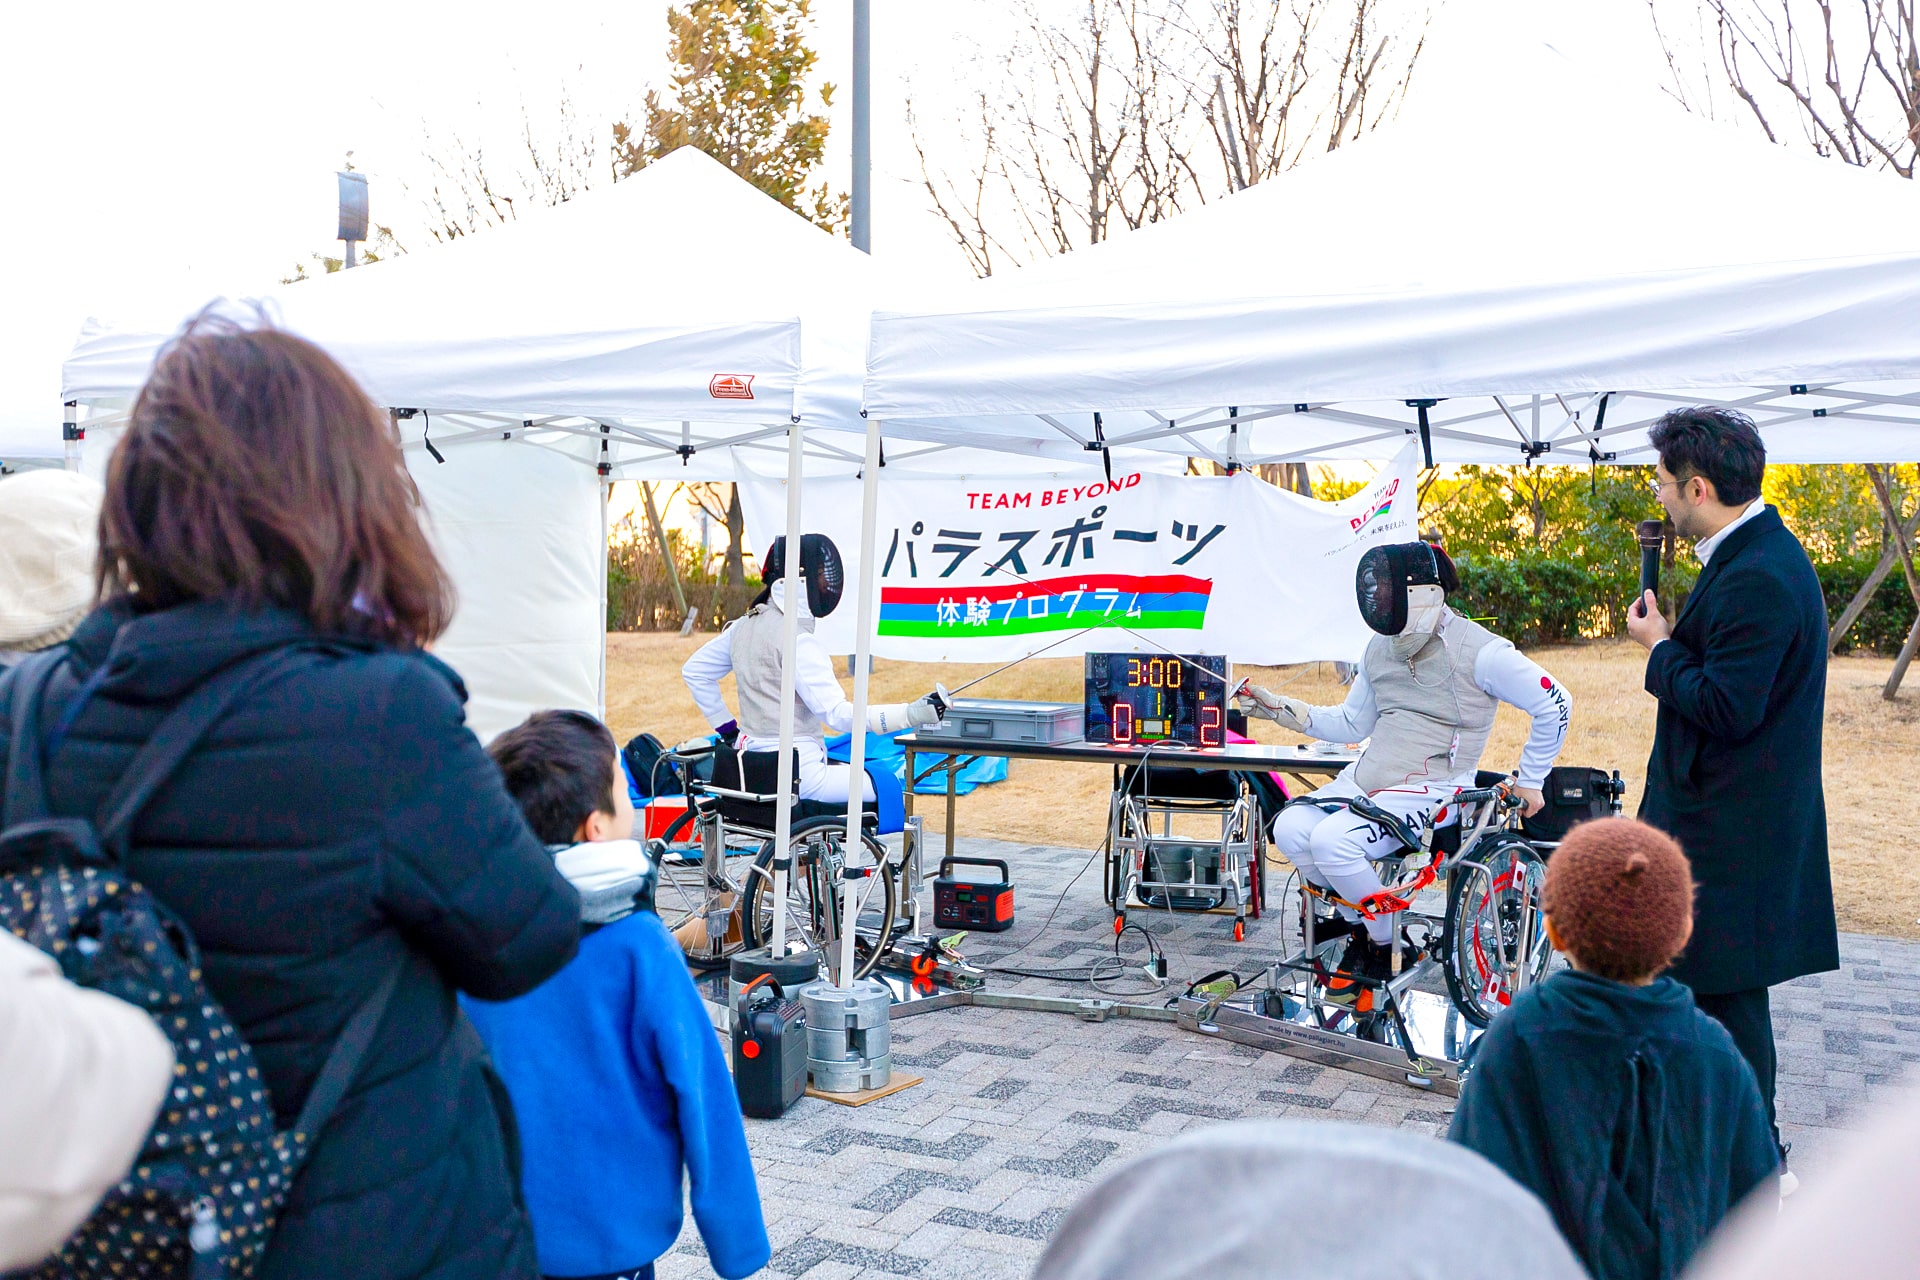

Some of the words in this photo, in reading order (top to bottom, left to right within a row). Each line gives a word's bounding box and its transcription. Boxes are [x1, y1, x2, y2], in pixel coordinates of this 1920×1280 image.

[967, 493, 1031, 509] TEAM
[1041, 473, 1141, 507] BEYOND
[881, 505, 1227, 578] パラスポーツ
[936, 583, 1142, 627] 体験プログラム
[1128, 658, 1181, 688] 3:00
[1113, 703, 1132, 741] 0
[1200, 706, 1220, 745] 2
[1546, 683, 1569, 744] JAPAN
[1348, 807, 1431, 843] JAAN
[1268, 1025, 1283, 1033] made
[1285, 1028, 1292, 1036] by
